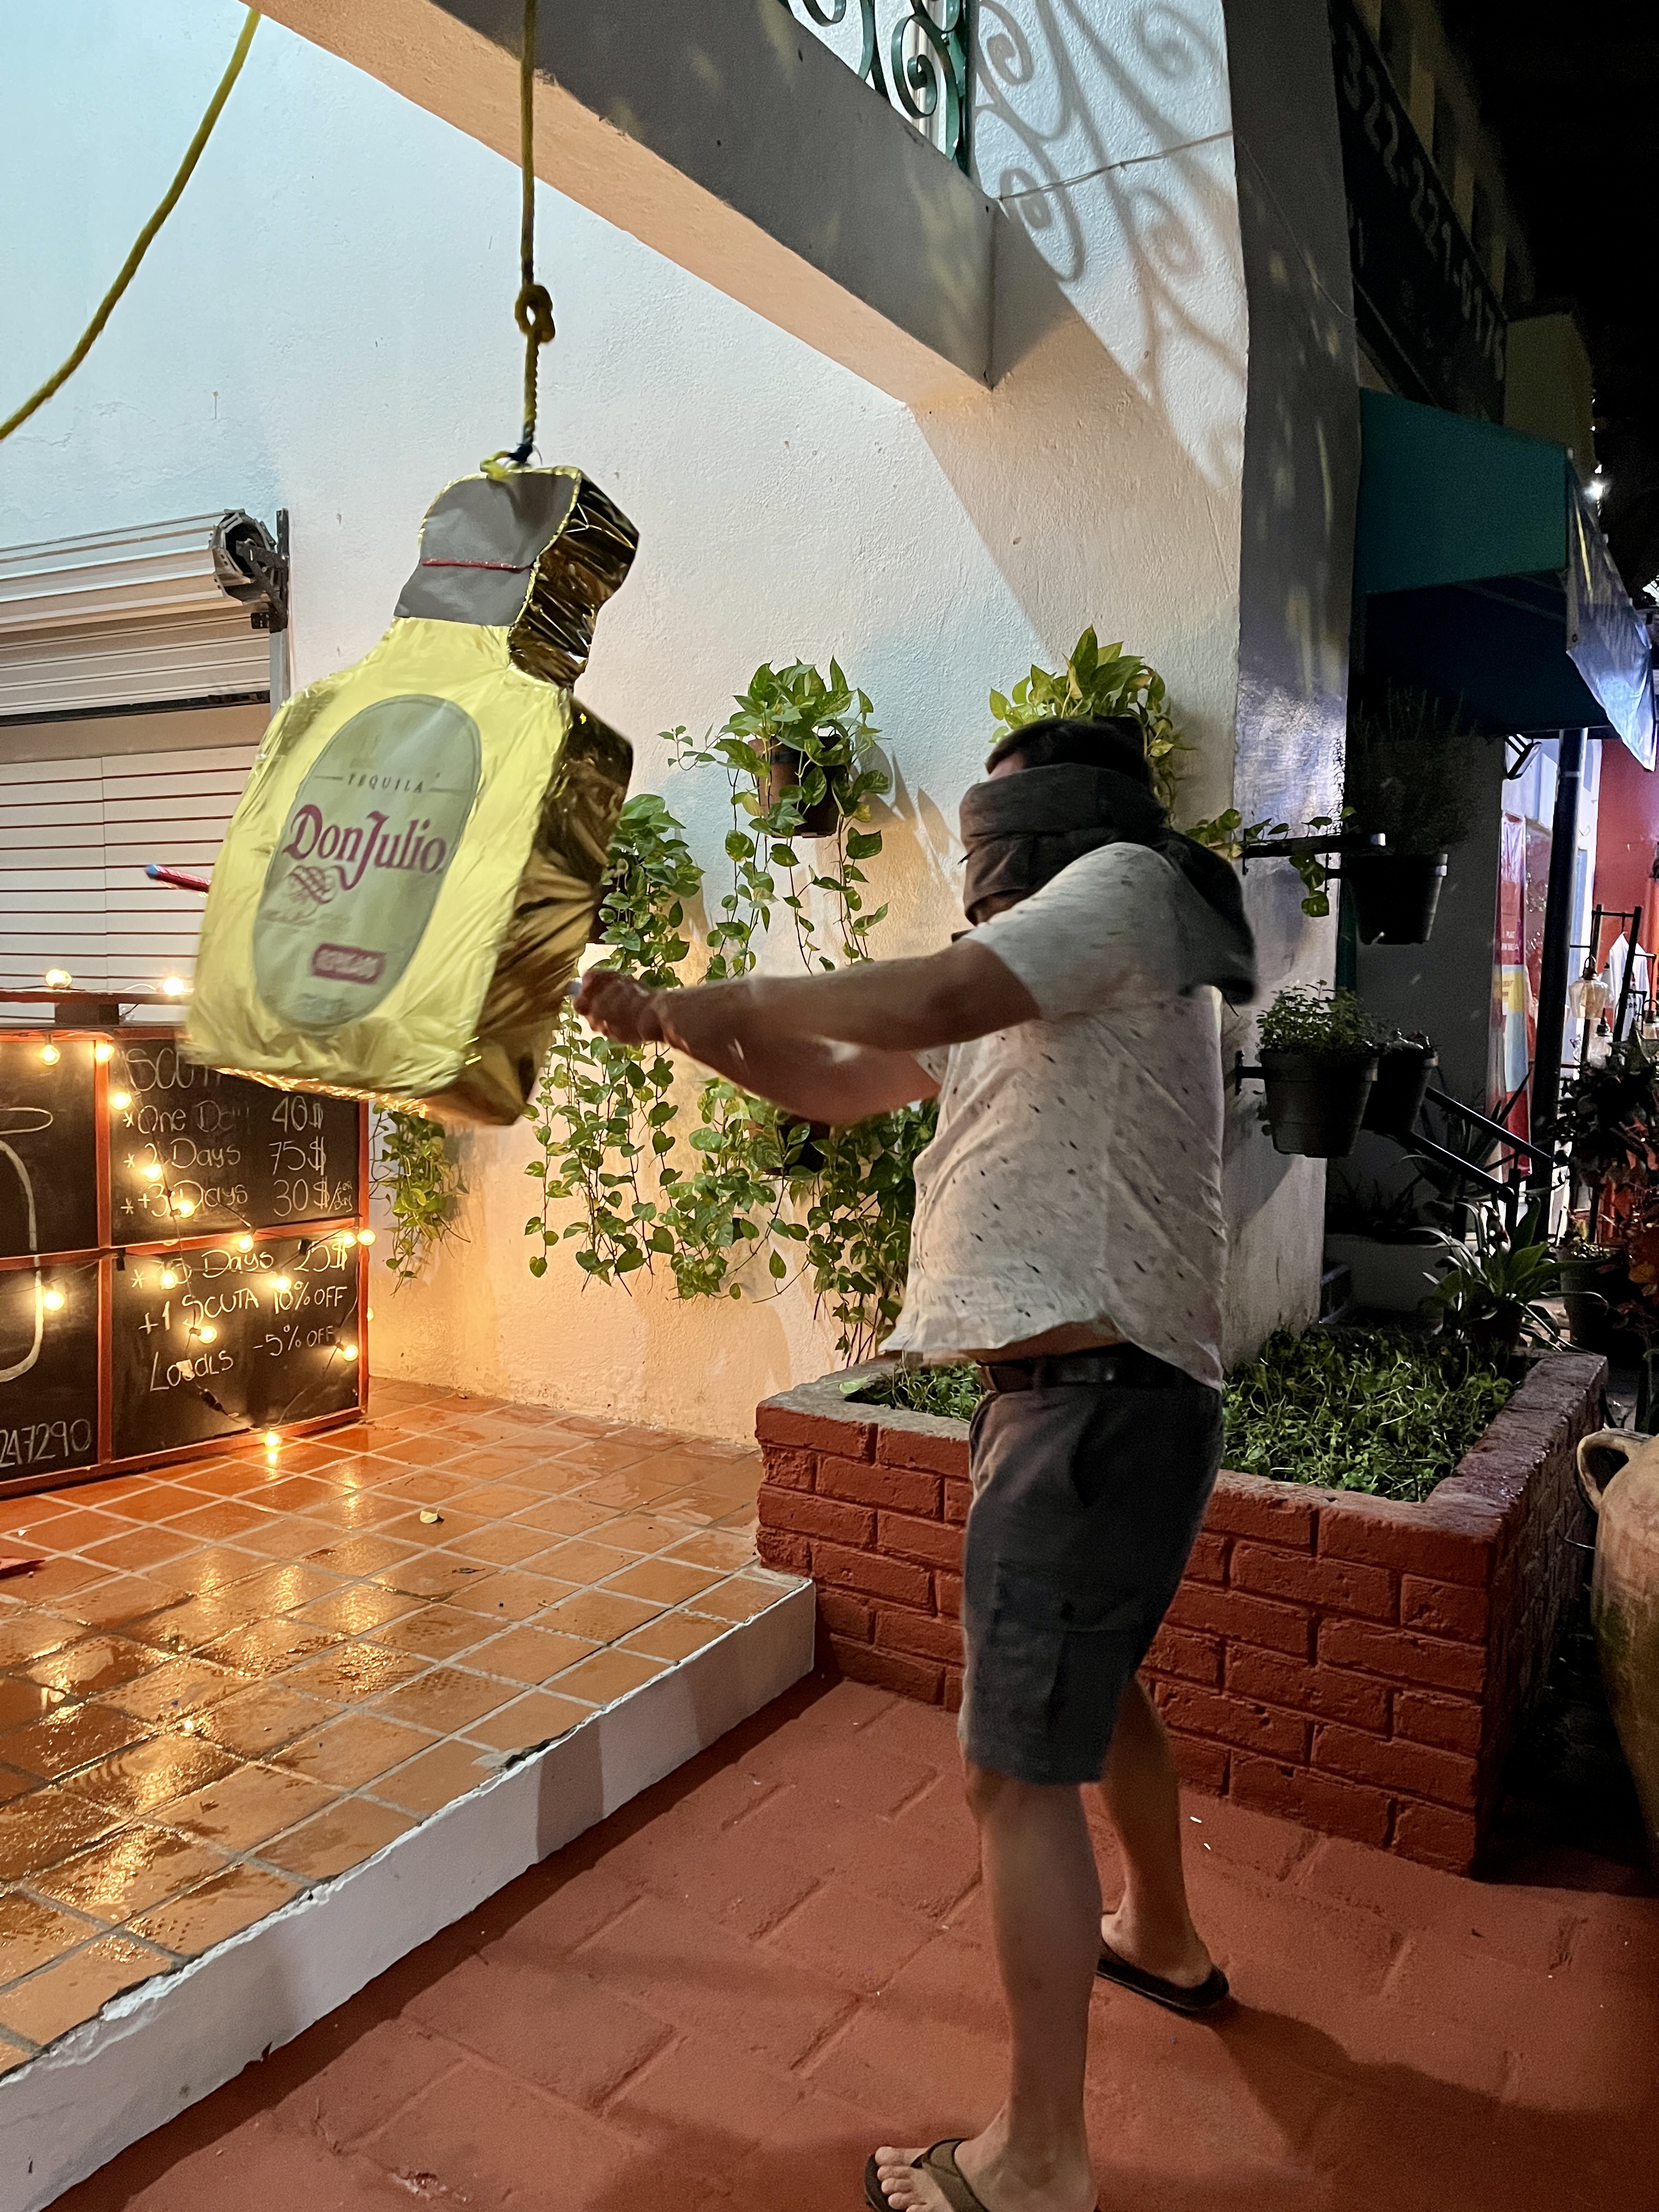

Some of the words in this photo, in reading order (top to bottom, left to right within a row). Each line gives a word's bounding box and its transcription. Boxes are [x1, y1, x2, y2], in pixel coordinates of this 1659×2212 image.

[348, 772, 424, 794] TEQUILA
[282, 804, 365, 863] Don
[332, 810, 448, 890] Julio
[138, 1104, 187, 1134] One
[271, 1095, 324, 1133] 40$
[170, 1137, 241, 1169] Days
[269, 1136, 326, 1176] 75$
[173, 1180, 248, 1210] Days
[201, 1249, 274, 1278] Days
[306, 1325, 334, 1347] OFF
